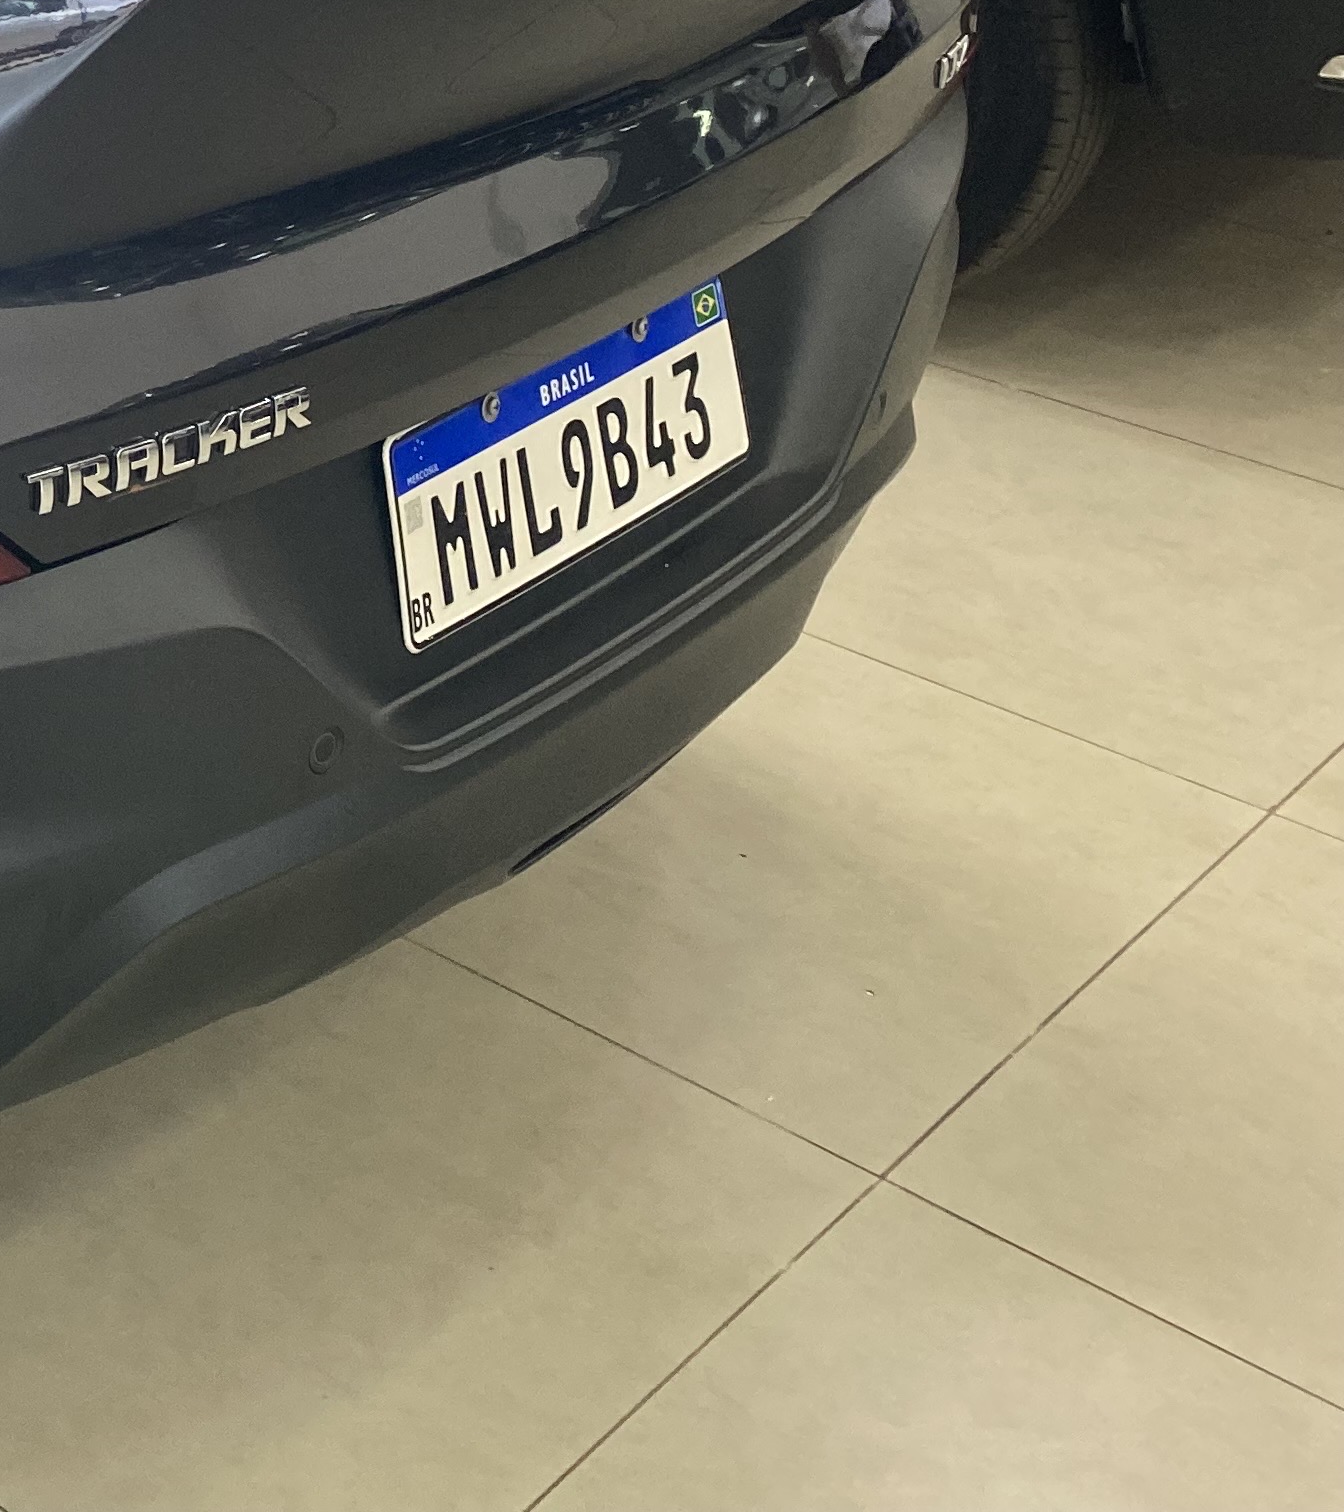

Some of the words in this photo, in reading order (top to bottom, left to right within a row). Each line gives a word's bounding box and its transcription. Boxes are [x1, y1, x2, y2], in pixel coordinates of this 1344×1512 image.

[538, 362, 595, 407] BRASIL
[25, 387, 312, 516] TRACKER
[430, 351, 711, 607] MWL9B43
[410, 591, 435, 634] BR
